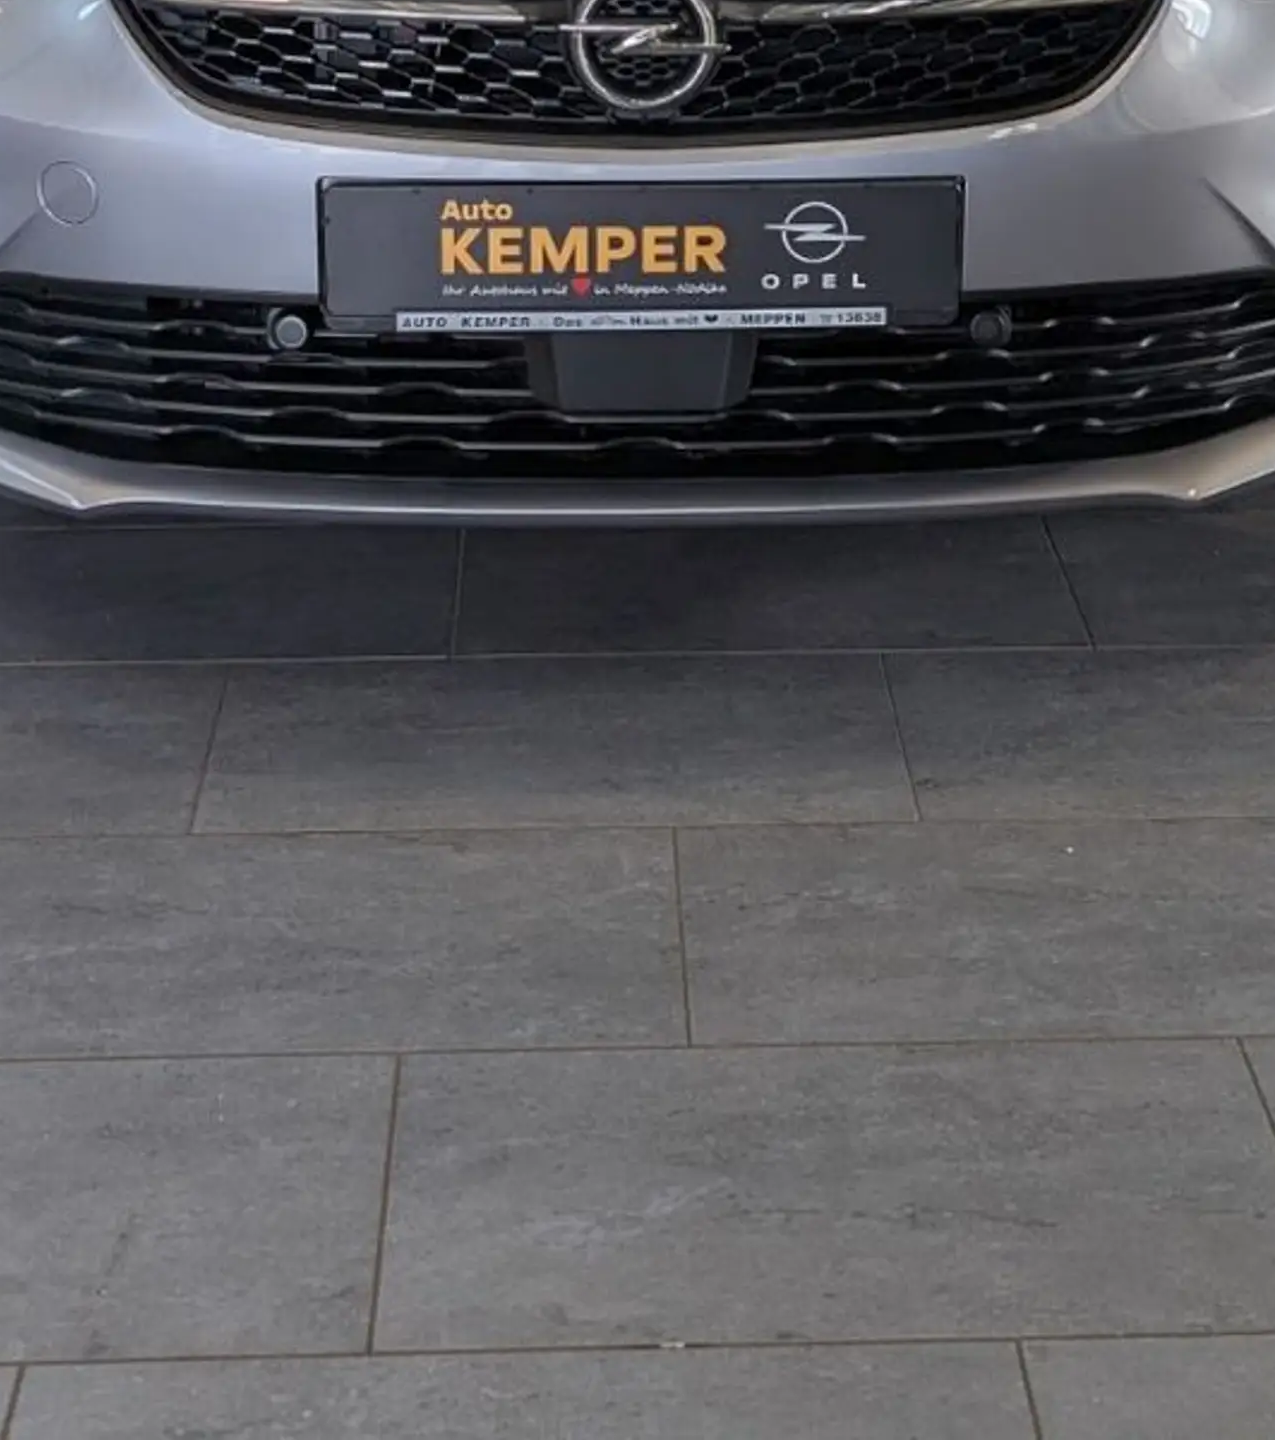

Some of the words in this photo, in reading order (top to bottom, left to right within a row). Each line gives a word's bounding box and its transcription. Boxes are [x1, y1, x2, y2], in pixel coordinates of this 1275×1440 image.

[441, 199, 512, 220] Auto
[441, 226, 726, 273] KEMPER
[761, 273, 866, 289] OPEL
[402, 317, 448, 328] AUTO
[461, 316, 530, 328] KEMPER
